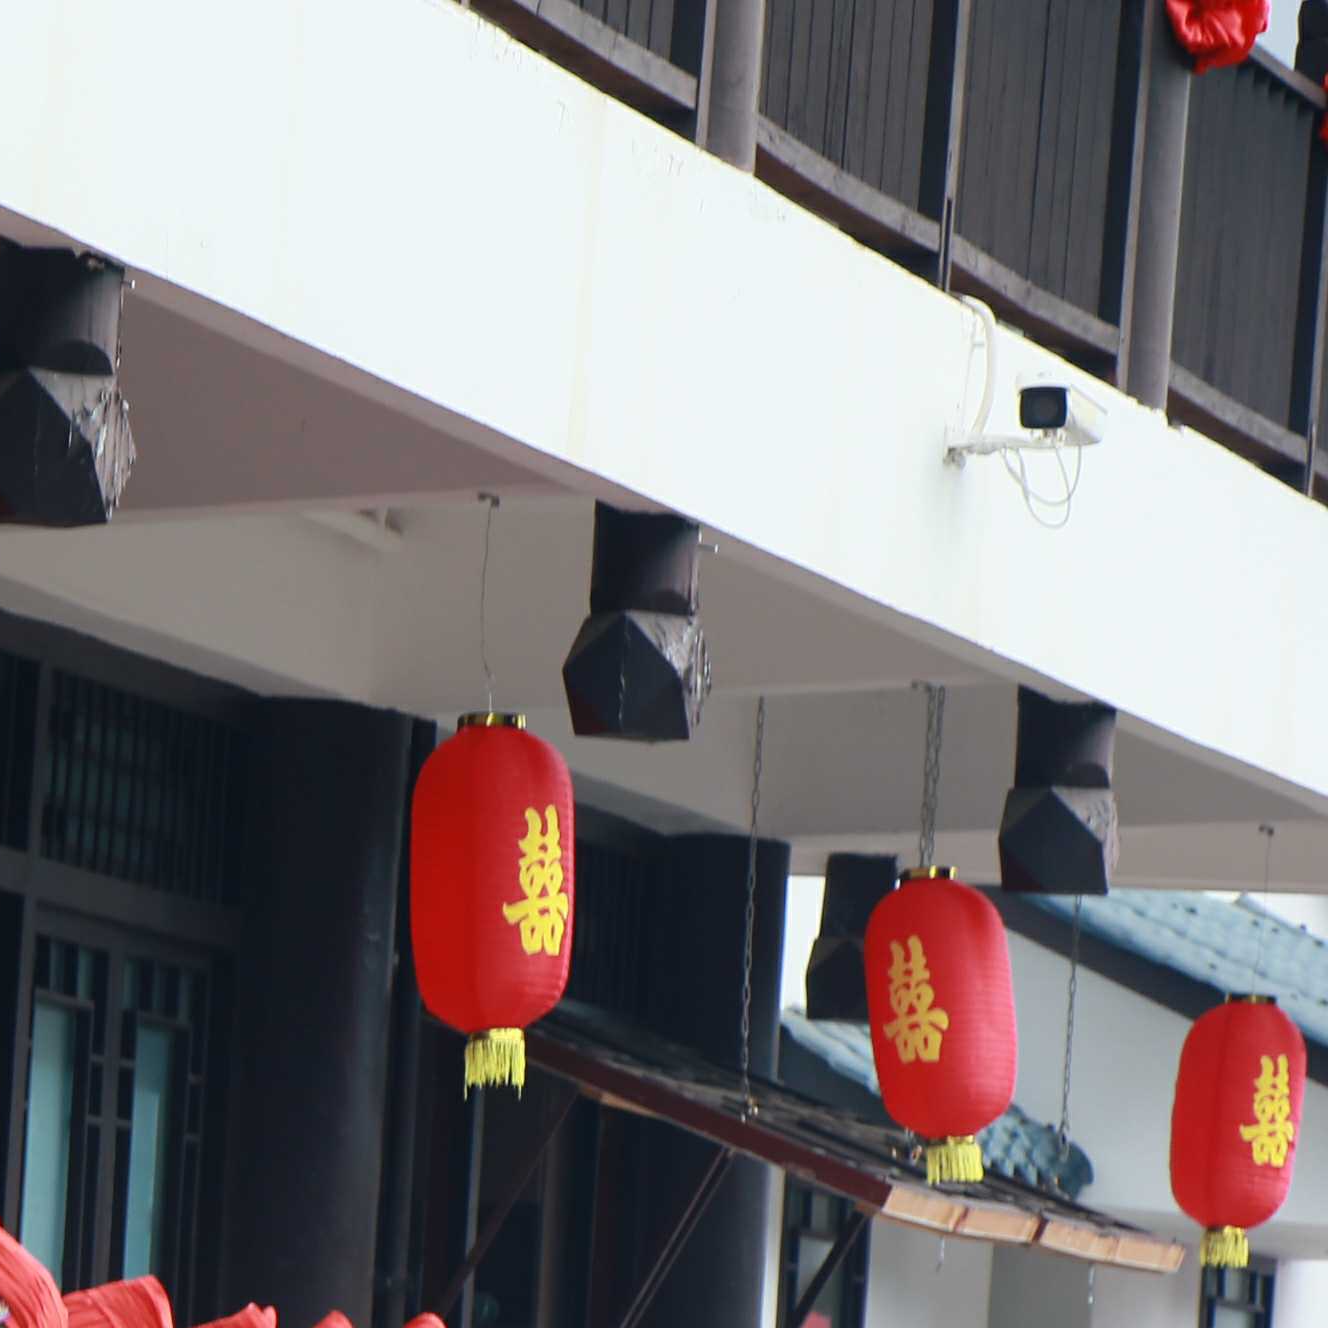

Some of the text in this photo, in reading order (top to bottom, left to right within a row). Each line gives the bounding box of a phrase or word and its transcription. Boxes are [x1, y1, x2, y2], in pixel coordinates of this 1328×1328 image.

[502, 803, 570, 957] 囍
[884, 934, 950, 1064] 囍
[1240, 1054, 1295, 1168] 囍
